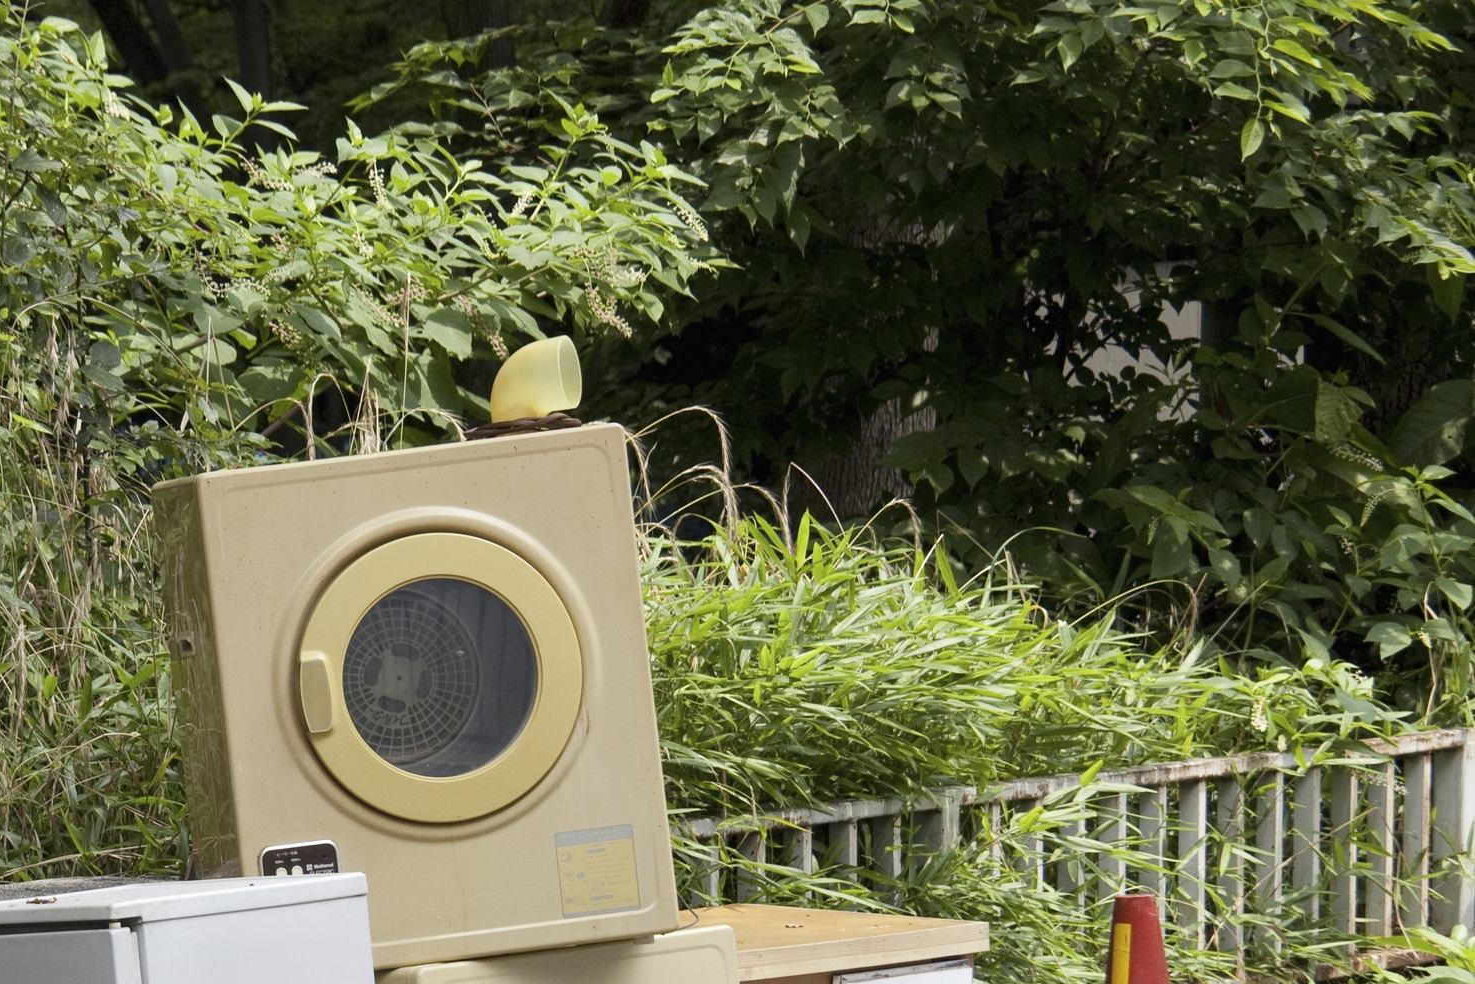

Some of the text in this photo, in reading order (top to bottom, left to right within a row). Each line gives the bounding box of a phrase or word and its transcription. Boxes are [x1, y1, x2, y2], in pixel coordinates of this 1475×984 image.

[369, 708, 410, 726] フィルター
